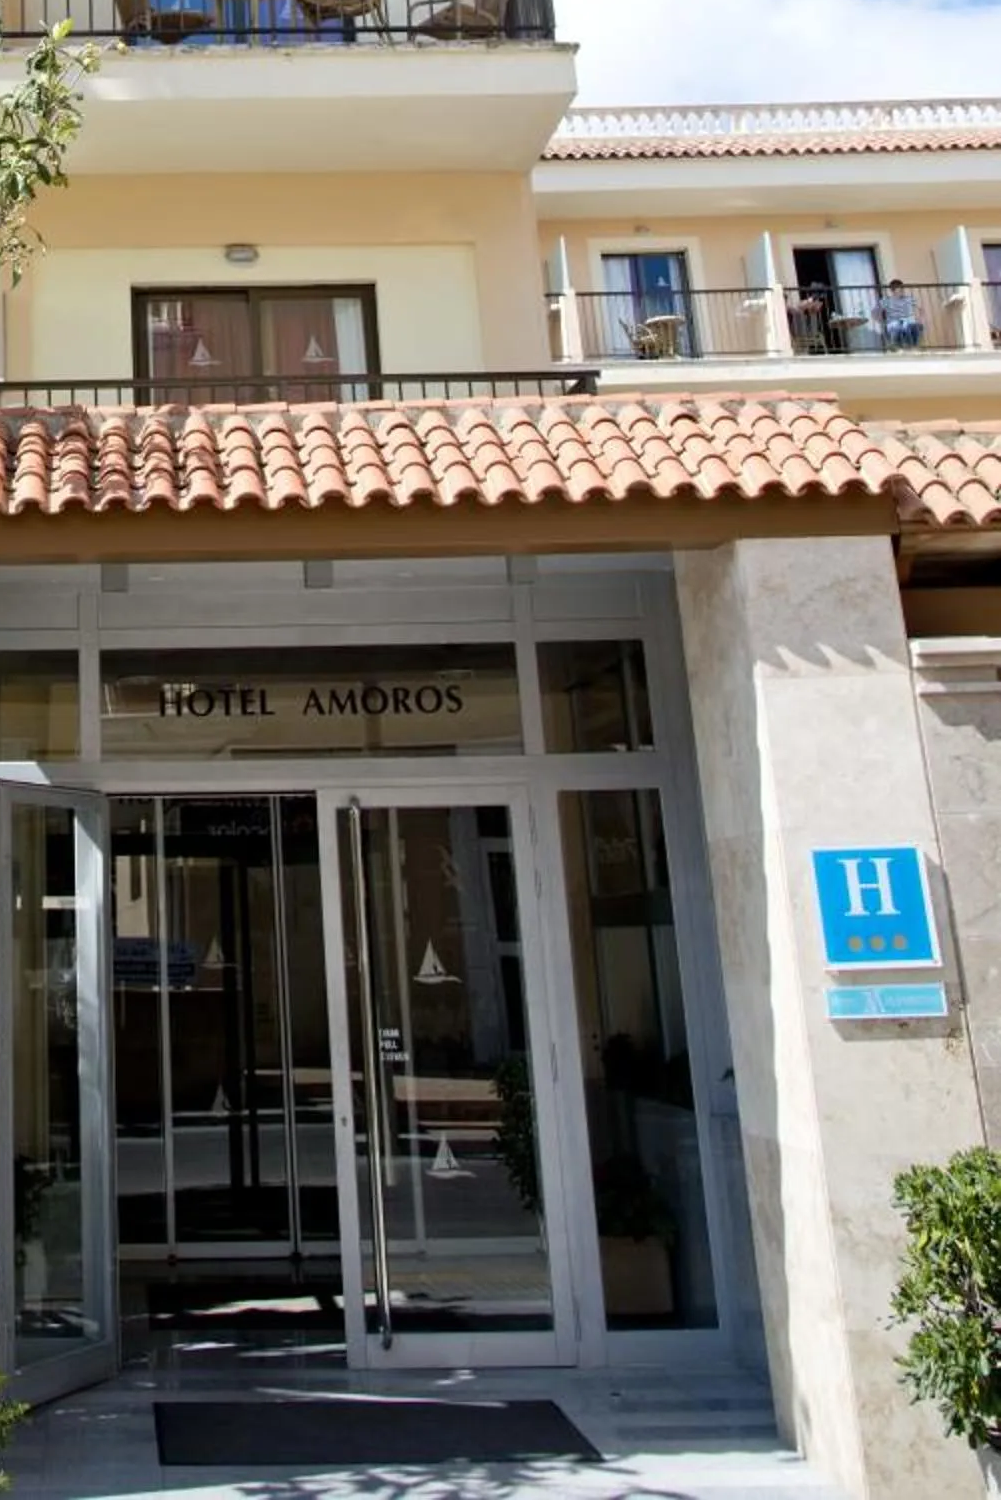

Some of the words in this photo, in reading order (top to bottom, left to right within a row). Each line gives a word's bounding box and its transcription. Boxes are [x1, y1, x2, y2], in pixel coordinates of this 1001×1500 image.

[158, 688, 276, 717] HOTEL
[302, 684, 464, 715] AMOROS
[836, 856, 901, 917] H
